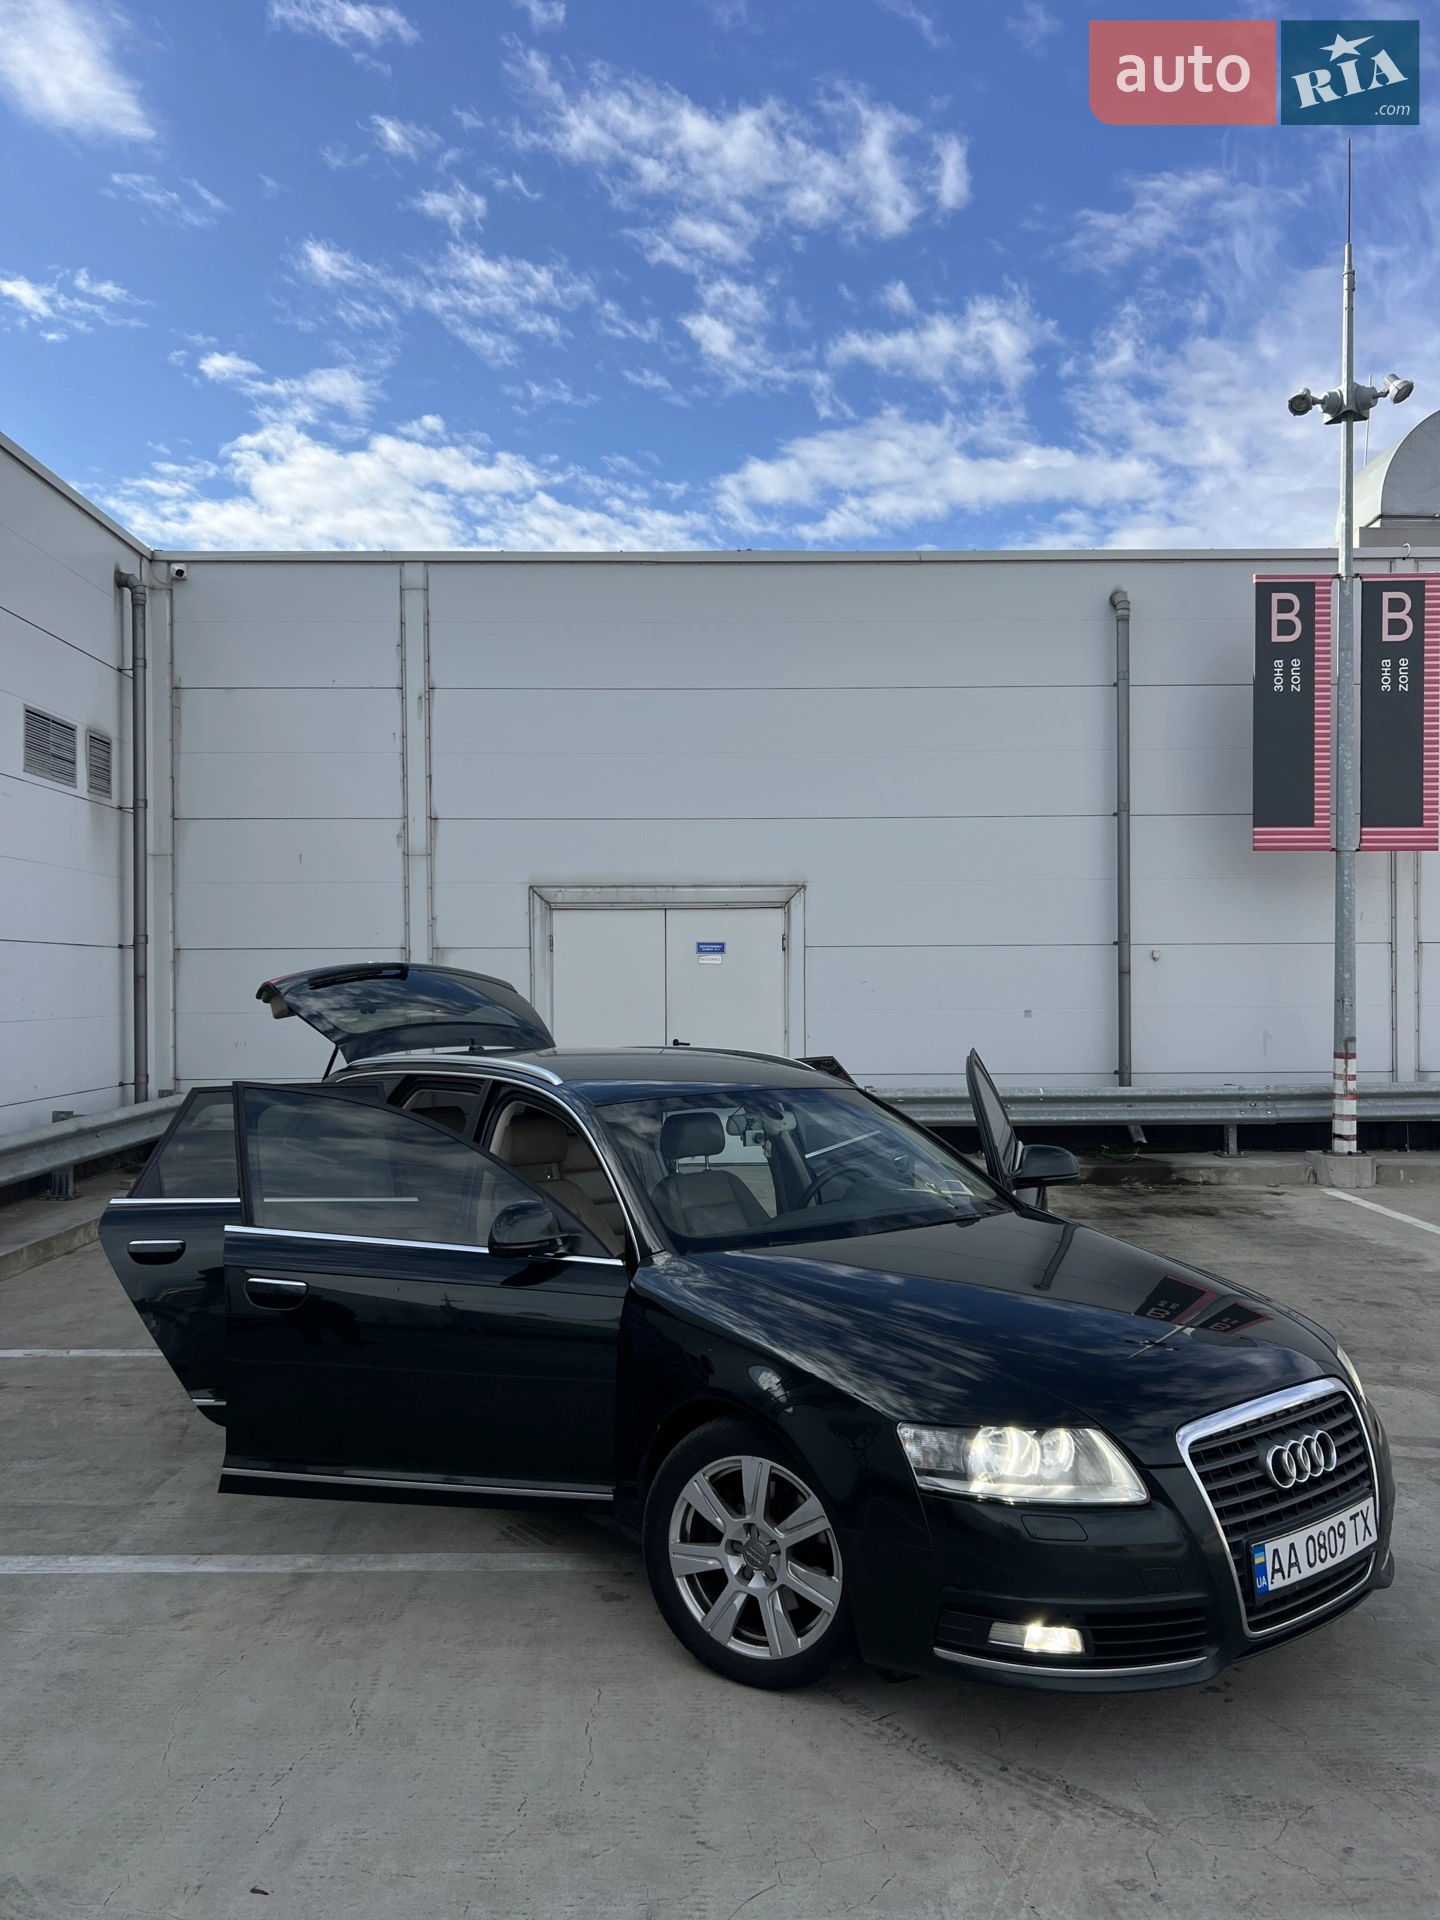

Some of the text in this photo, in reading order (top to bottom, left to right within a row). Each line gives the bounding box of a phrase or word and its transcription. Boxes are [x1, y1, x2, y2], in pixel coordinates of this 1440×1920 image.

[1271, 592, 1303, 643] B
[1381, 591, 1414, 642] B
[1273, 659, 1284, 692] зона
[1290, 658, 1301, 692] zone
[1381, 659, 1392, 692] зона
[1398, 657, 1409, 692] zone
[1270, 1505, 1372, 1585] AA 0809 TX
[1256, 1575, 1268, 1588] UA
